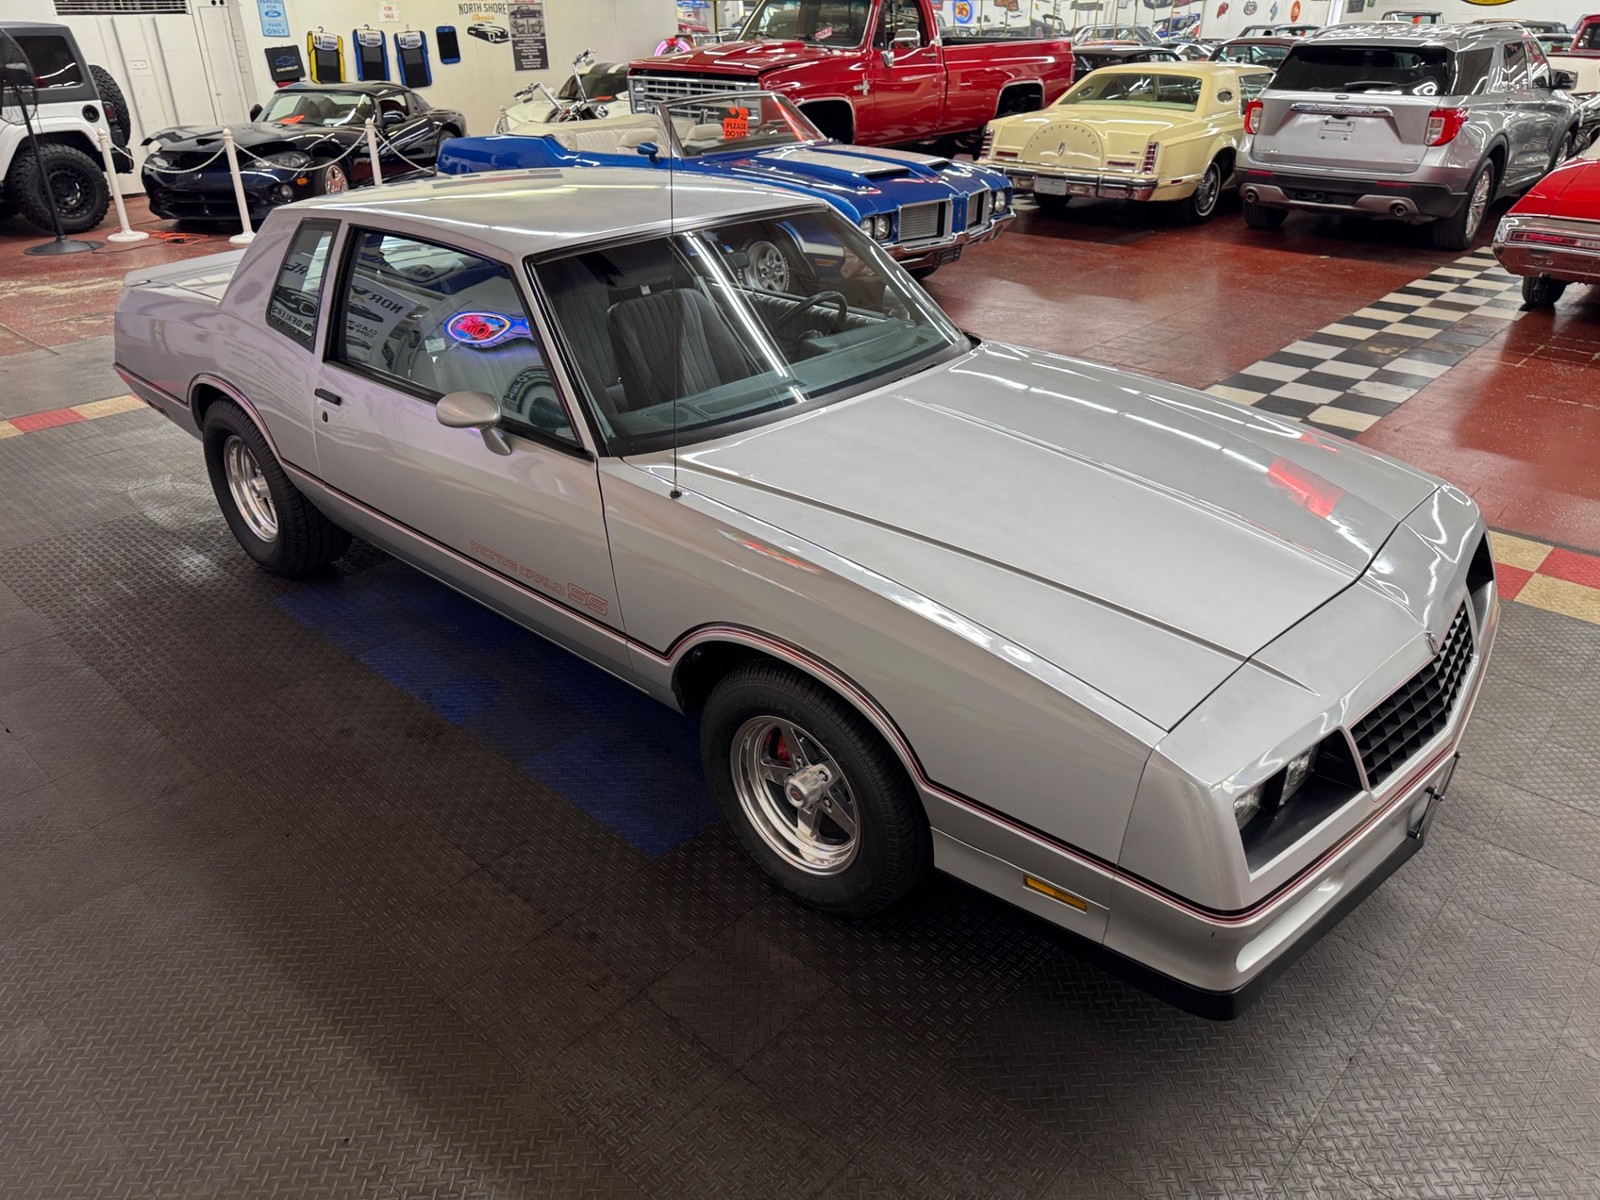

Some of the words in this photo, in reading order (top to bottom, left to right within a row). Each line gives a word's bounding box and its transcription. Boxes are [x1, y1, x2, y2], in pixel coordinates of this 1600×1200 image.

[458, 3, 482, 15] NORTH
[483, 3, 507, 15] SHORE
[726, 122, 747, 130] PLEASE
[470, 540, 518, 573] MONTE
[520, 565, 565, 596] CARLO
[567, 582, 608, 617] SS
